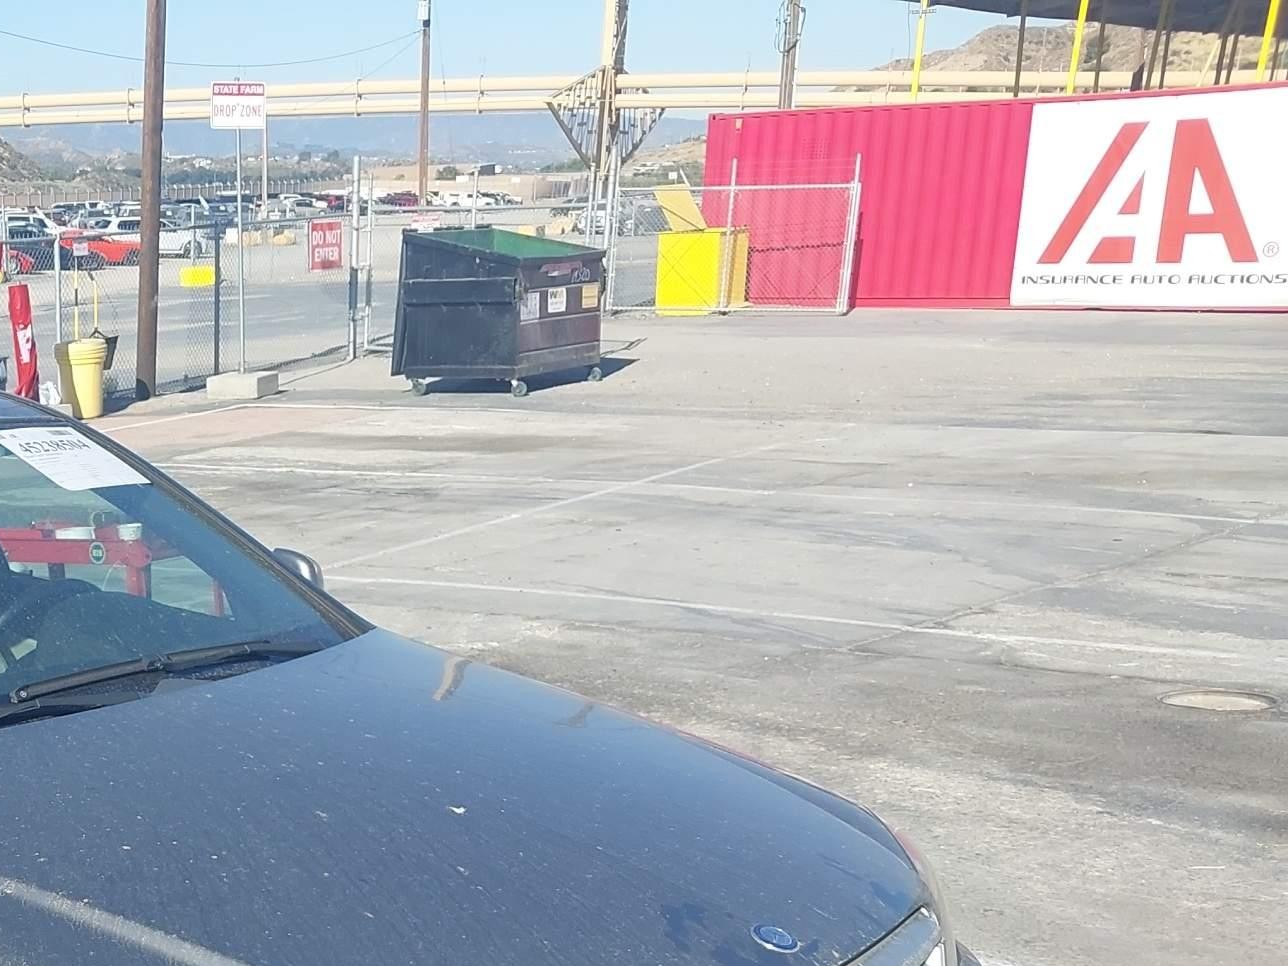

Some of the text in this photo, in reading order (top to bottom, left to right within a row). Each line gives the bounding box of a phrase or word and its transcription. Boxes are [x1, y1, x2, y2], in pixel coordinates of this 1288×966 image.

[213, 85, 264, 95] STATE FARM
[213, 103, 262, 118] DROP ZONE
[312, 229, 341, 246] DO NOT
[314, 246, 340, 263] ENTER
[1021, 273, 1288, 285] INSURANCE AUTO AUCTIONS
[18, 438, 91, 455] 45238504
